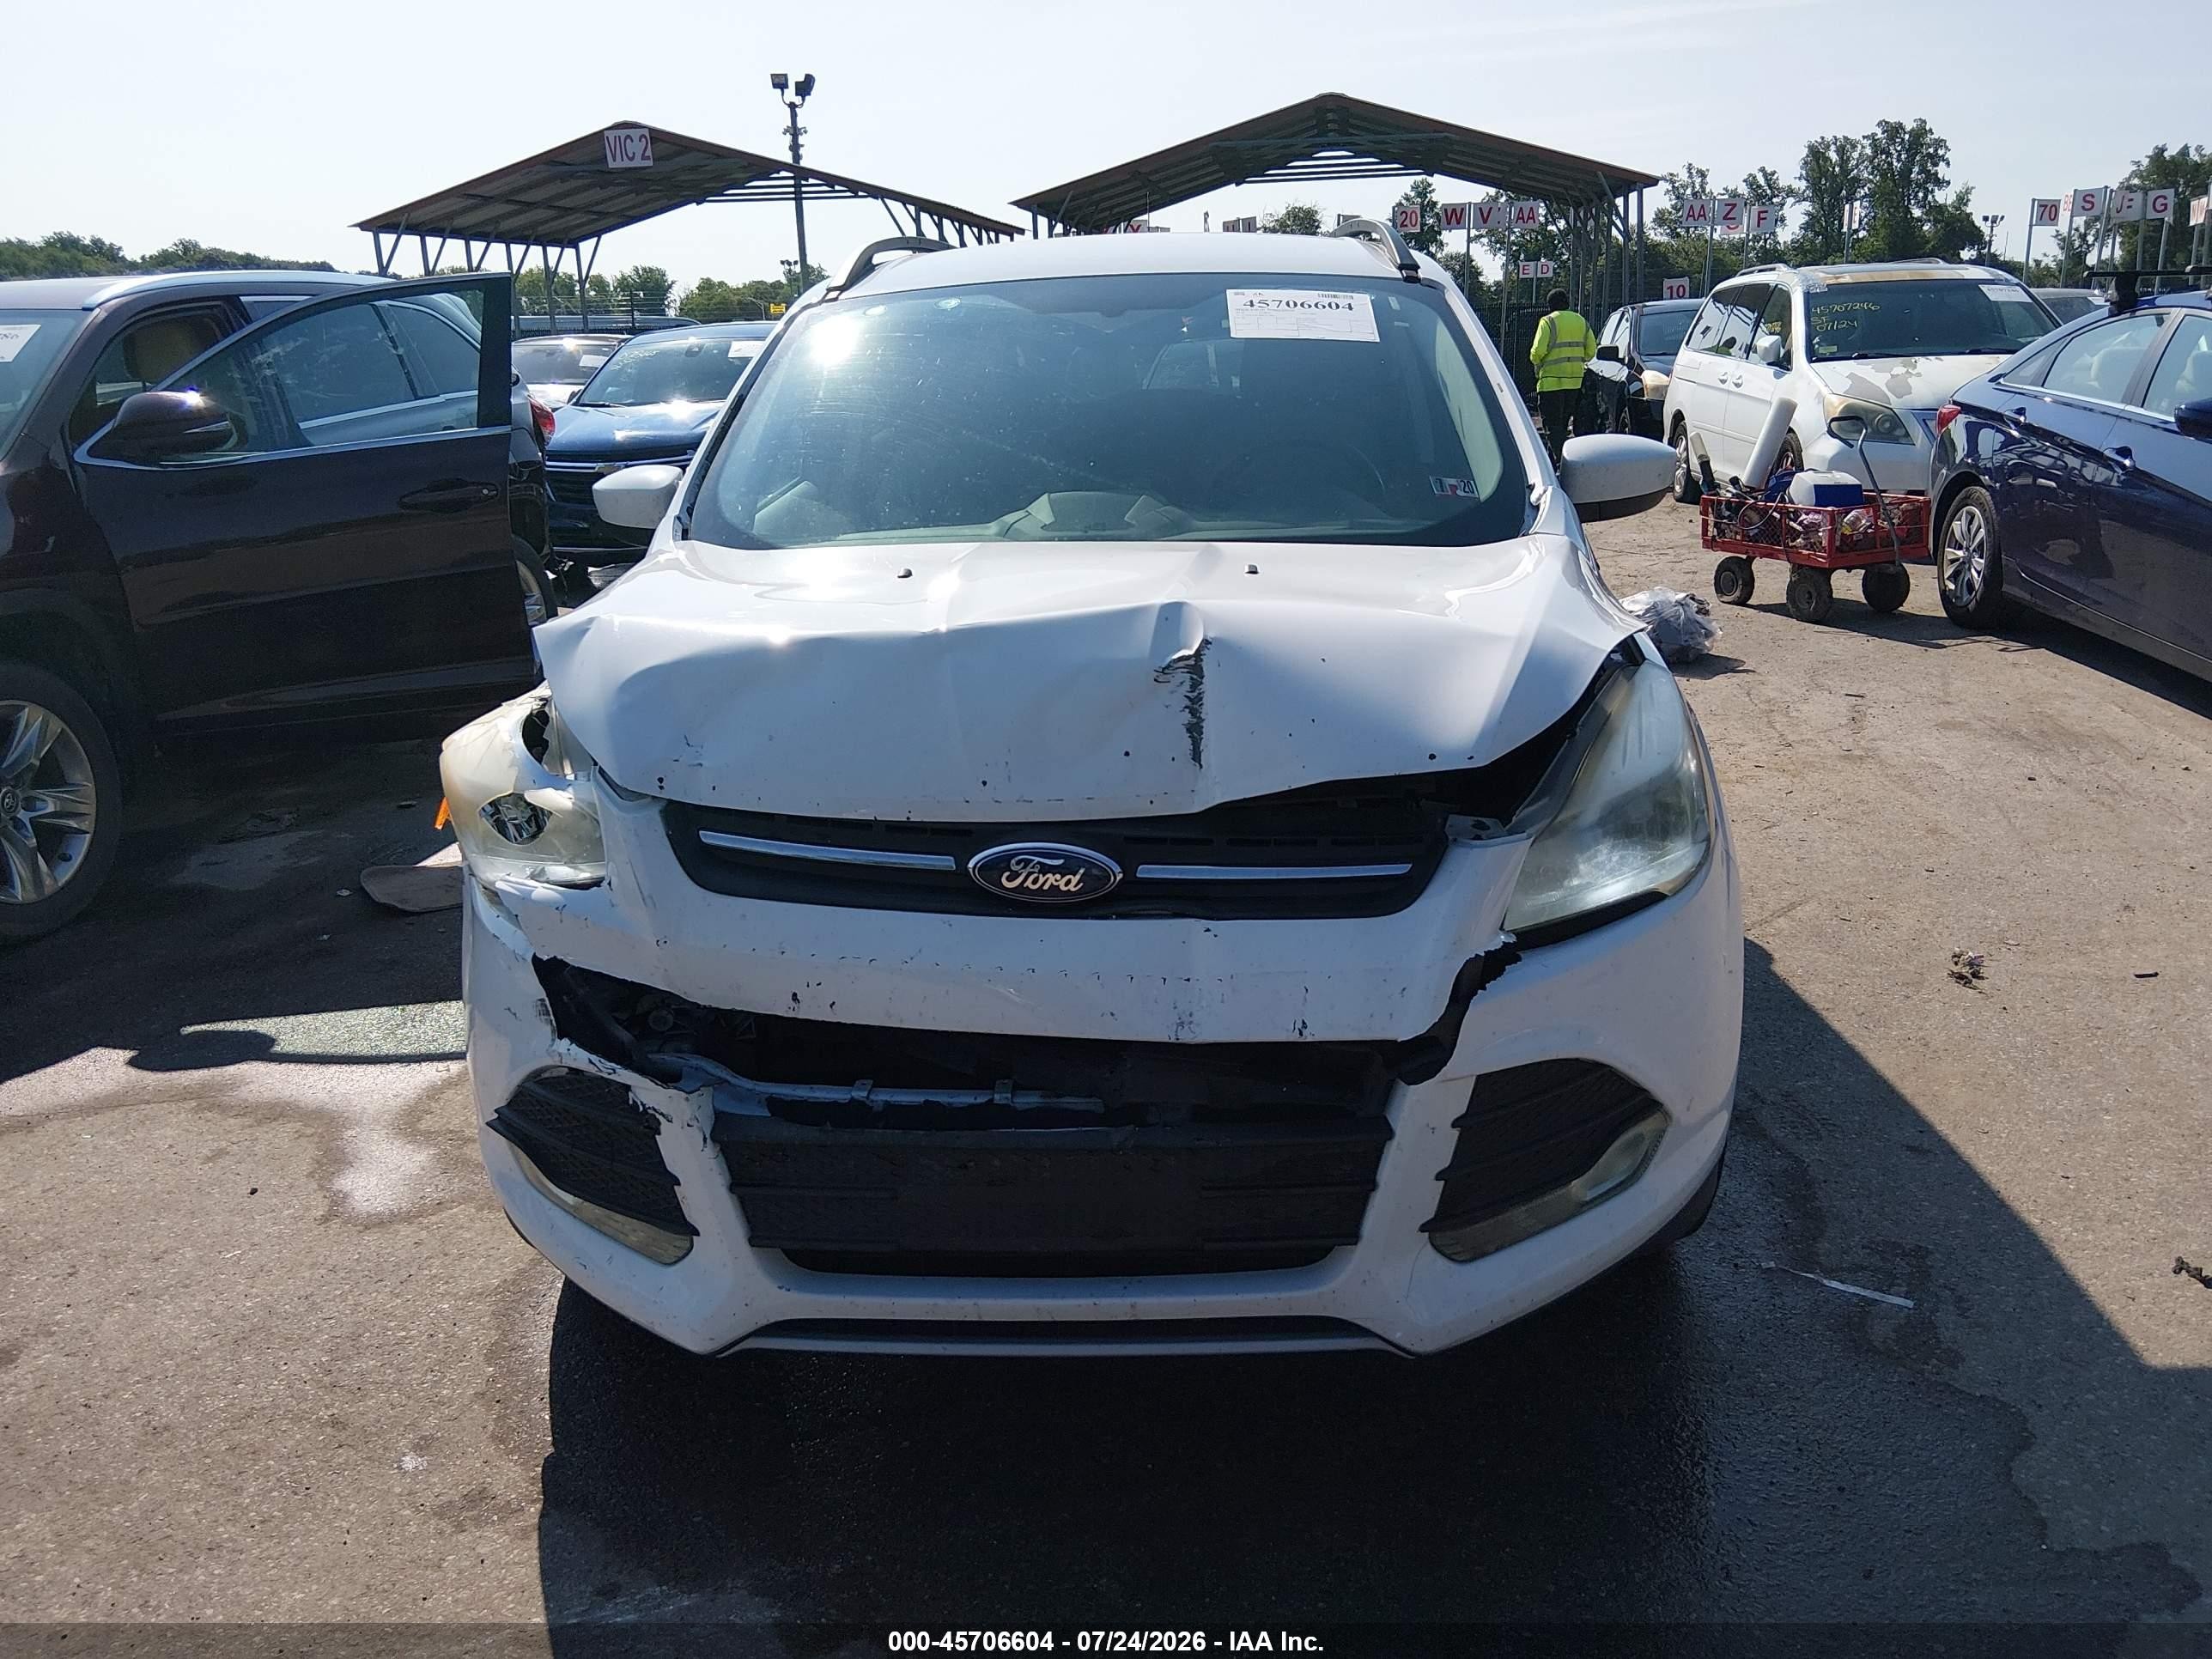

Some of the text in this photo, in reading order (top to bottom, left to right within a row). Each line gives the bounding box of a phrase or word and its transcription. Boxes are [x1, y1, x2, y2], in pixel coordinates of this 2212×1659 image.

[605, 134, 651, 162] VIC 2
[2081, 193, 2096, 211] S
[2152, 195, 2168, 214] G
[1399, 210, 1418, 228] 20
[1443, 208, 1465, 225] W
[1515, 206, 1536, 224] AA
[1686, 204, 1707, 222] AA
[1723, 203, 1737, 221] Z
[1757, 210, 1769, 228] F
[2039, 204, 2058, 222] 70
[1522, 264, 1530, 275] E
[1540, 264, 1550, 275] D
[1667, 284, 1686, 300] 10
[1243, 299, 1354, 311] 45706604
[1460, 480, 1475, 494] 20
[1001, 855, 1086, 892] Ford
